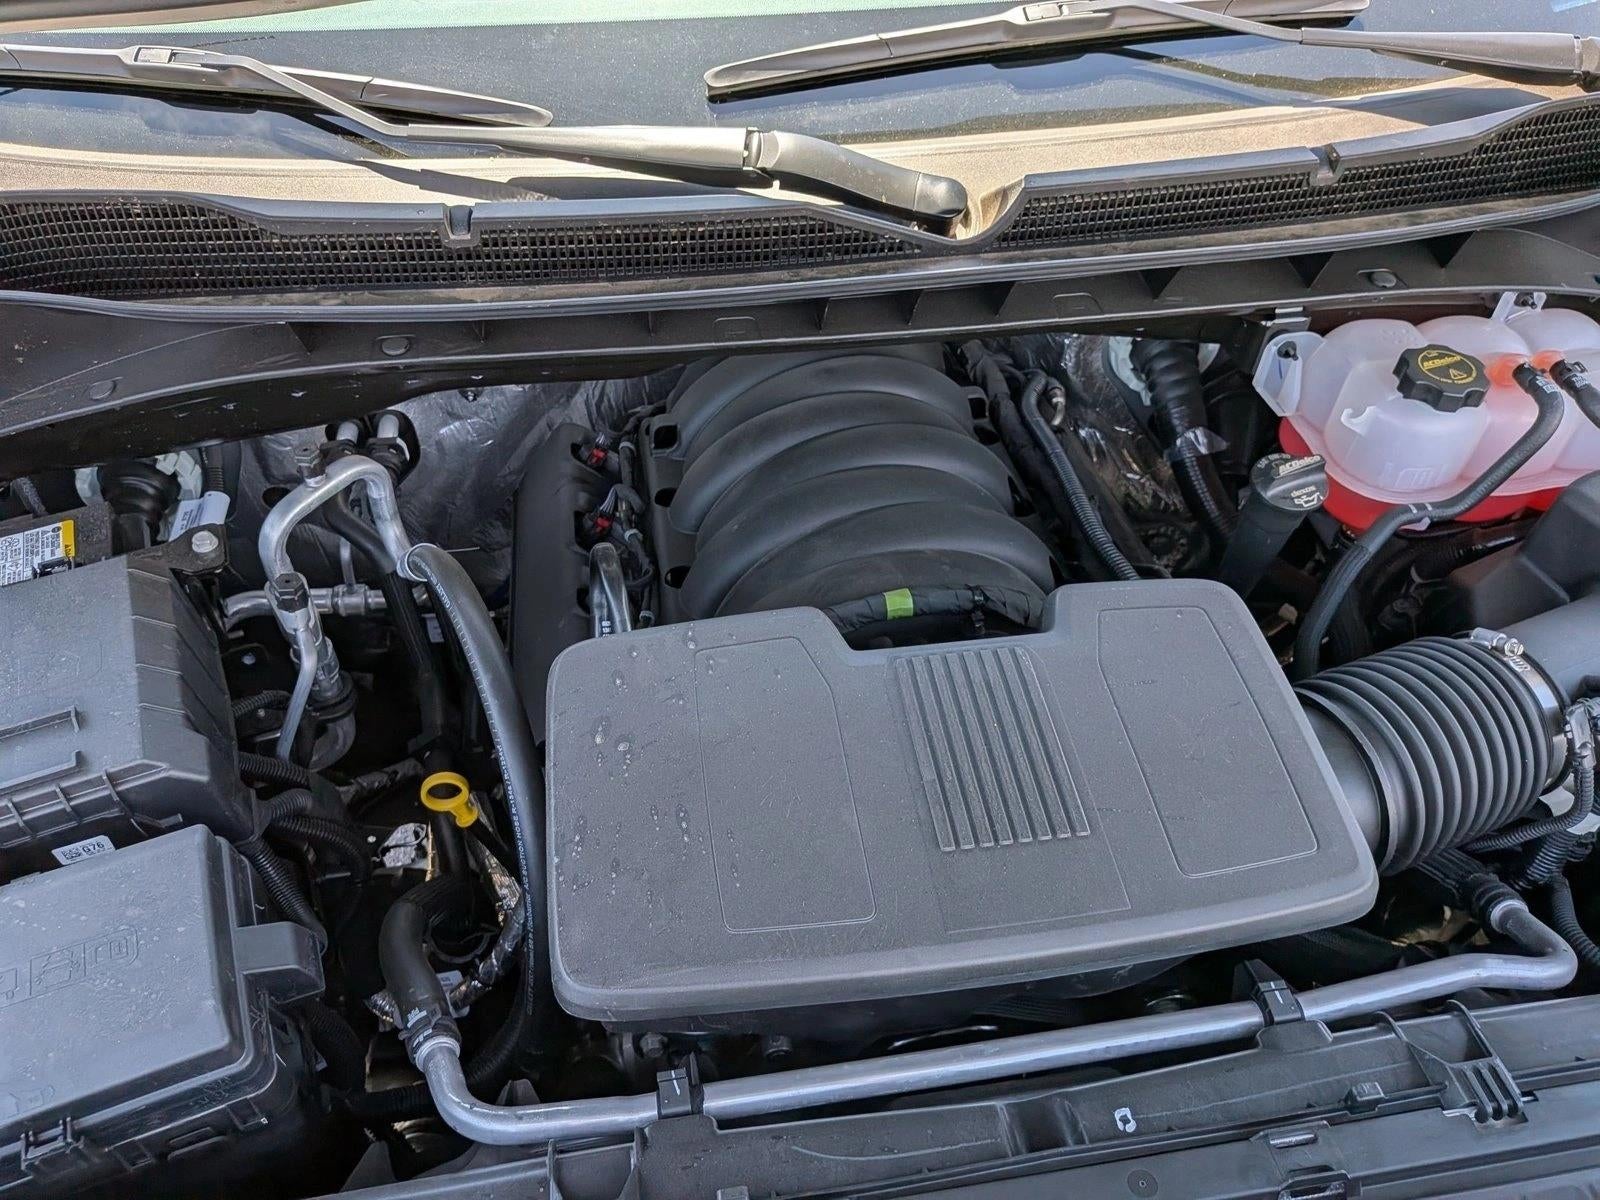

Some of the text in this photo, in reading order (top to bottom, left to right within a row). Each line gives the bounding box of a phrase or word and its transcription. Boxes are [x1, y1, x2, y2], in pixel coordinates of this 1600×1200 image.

[1423, 355, 1460, 369] ACDelco
[1279, 455, 1321, 473] ACDelco
[1291, 485, 1316, 498] dexos
[513, 815, 521, 839] HOSE
[81, 841, 105, 853] G76
[518, 840, 528, 875] SUCTION
